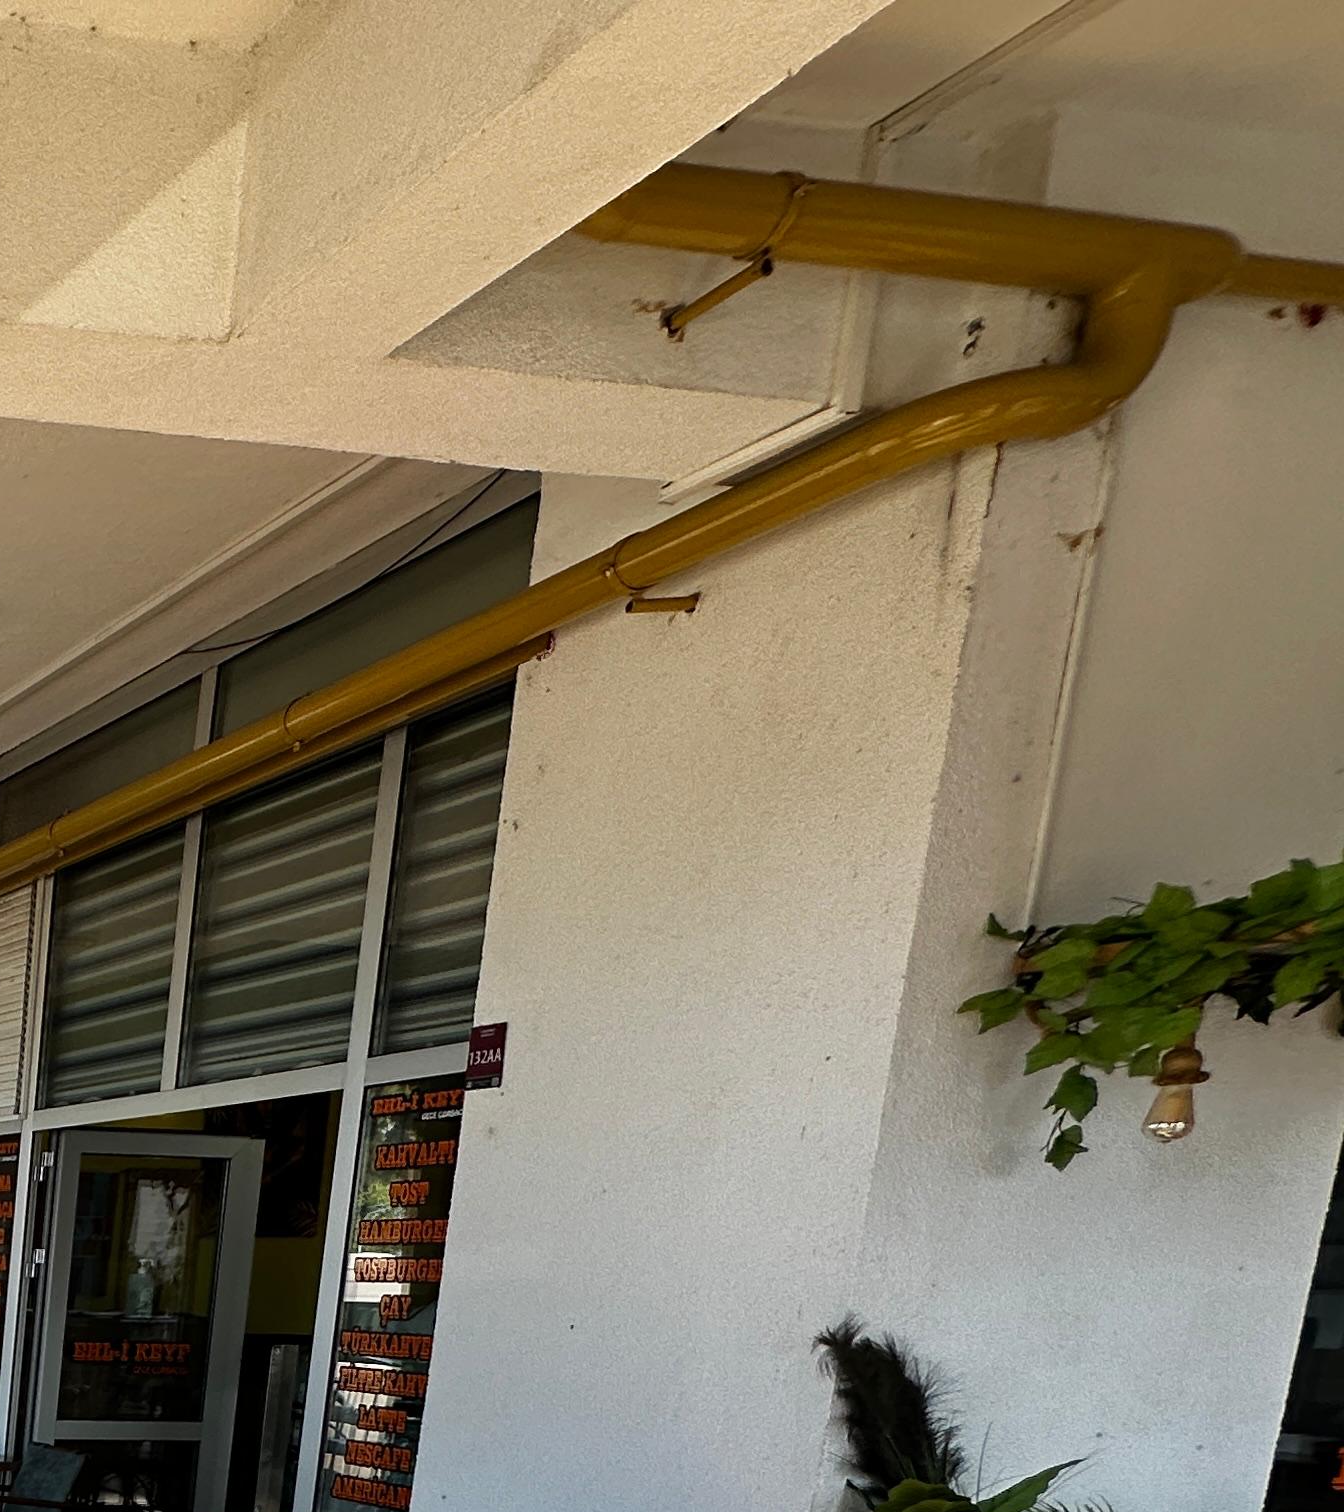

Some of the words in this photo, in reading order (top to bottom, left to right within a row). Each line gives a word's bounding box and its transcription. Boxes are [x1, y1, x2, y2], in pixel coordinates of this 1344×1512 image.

[422, 1089, 464, 1110] KEY
[376, 1140, 456, 1169] KAHVALTI
[390, 1182, 430, 1206] TOST
[380, 1294, 412, 1327] ÇAY
[358, 1404, 407, 1433] LATTE
